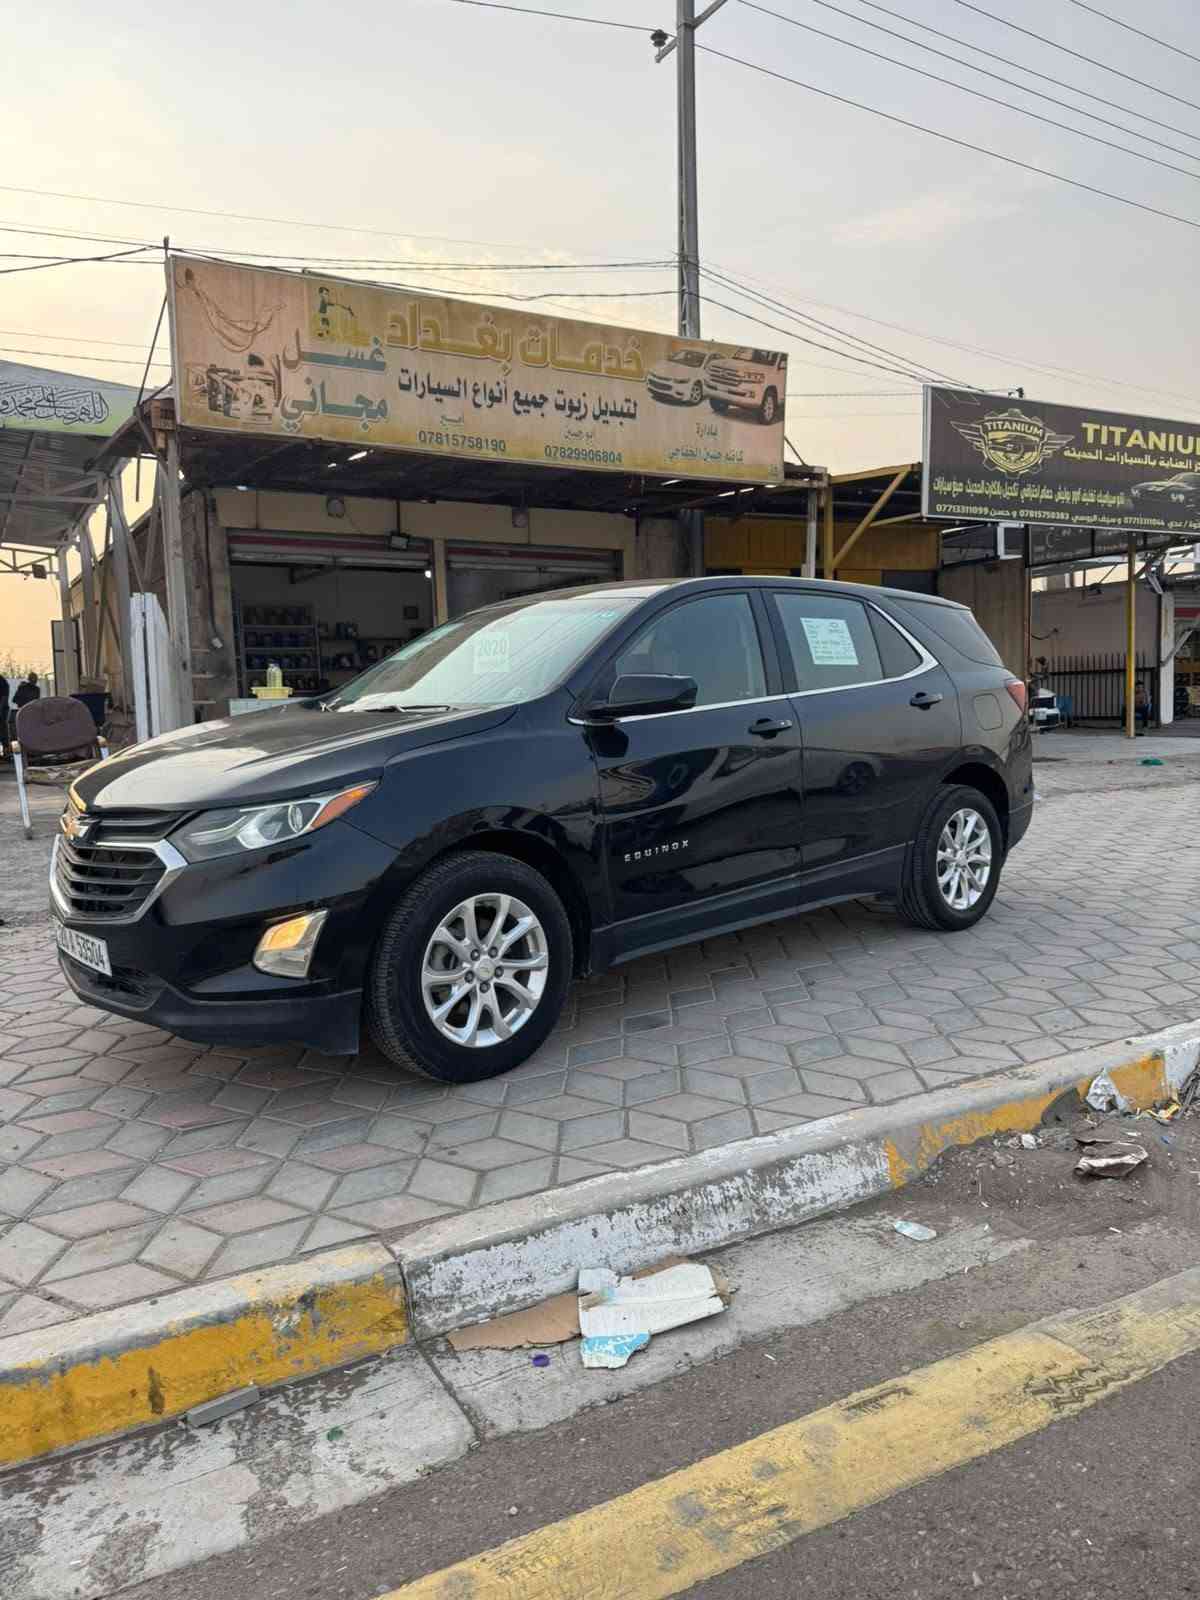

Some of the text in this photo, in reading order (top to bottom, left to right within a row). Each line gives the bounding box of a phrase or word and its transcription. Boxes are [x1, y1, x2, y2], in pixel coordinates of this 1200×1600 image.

[282, 328, 387, 373] غسل
[383, 303, 647, 382] خدمات بغداد
[398, 367, 467, 403] السيارات
[280, 377, 389, 432] مجاني
[512, 390, 549, 418] جميع
[555, 389, 588, 420] زيوت
[984, 421, 1043, 438] TITANIUM
[1081, 422, 1200, 457] TITANIU
[624, 839, 689, 862] EQUINOX
